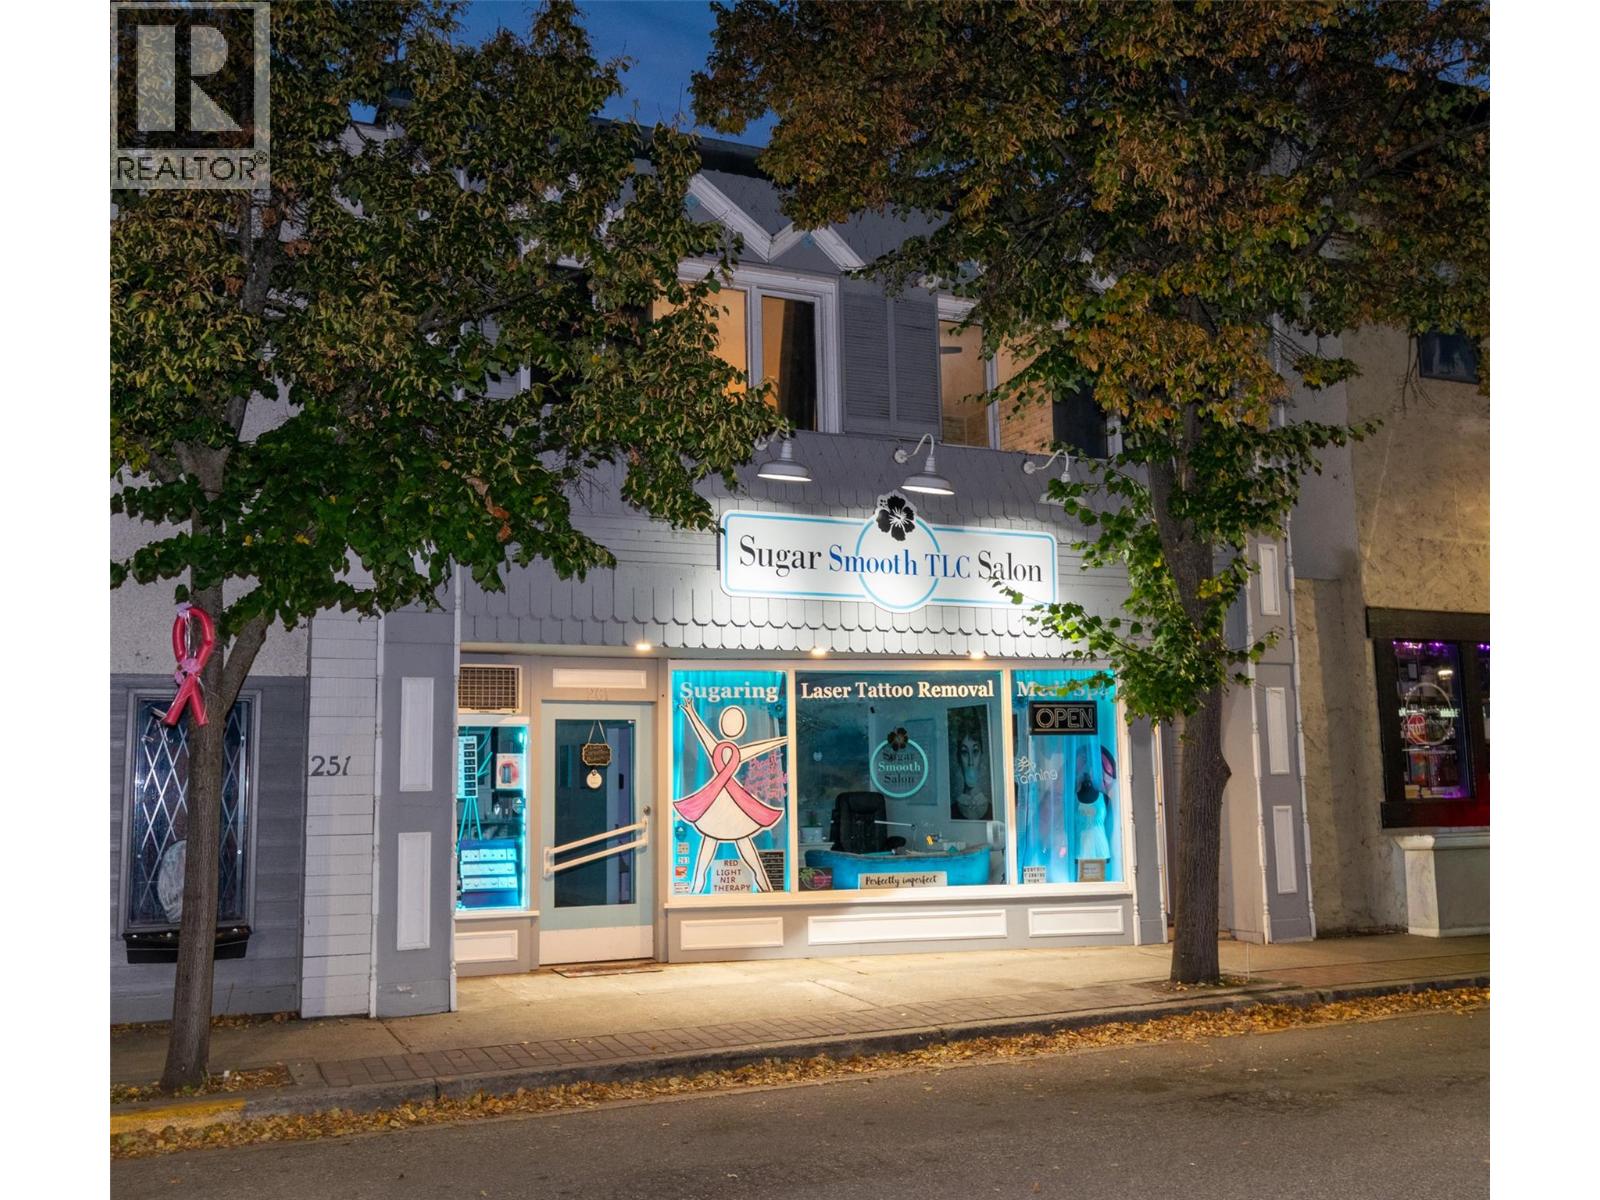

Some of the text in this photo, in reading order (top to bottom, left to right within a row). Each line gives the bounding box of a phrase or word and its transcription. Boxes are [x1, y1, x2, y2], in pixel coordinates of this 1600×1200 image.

[739, 534, 1042, 582] Sugar Smooth TLC Salon
[680, 682, 779, 702] Sugaring
[801, 680, 994, 699] Laser Tattoo Removal
[1036, 708, 1093, 728] OPEN
[311, 755, 351, 776] 251
[879, 761, 921, 771] Smooth
[884, 774, 914, 783] Salon
[716, 869, 742, 877] LIGHT
